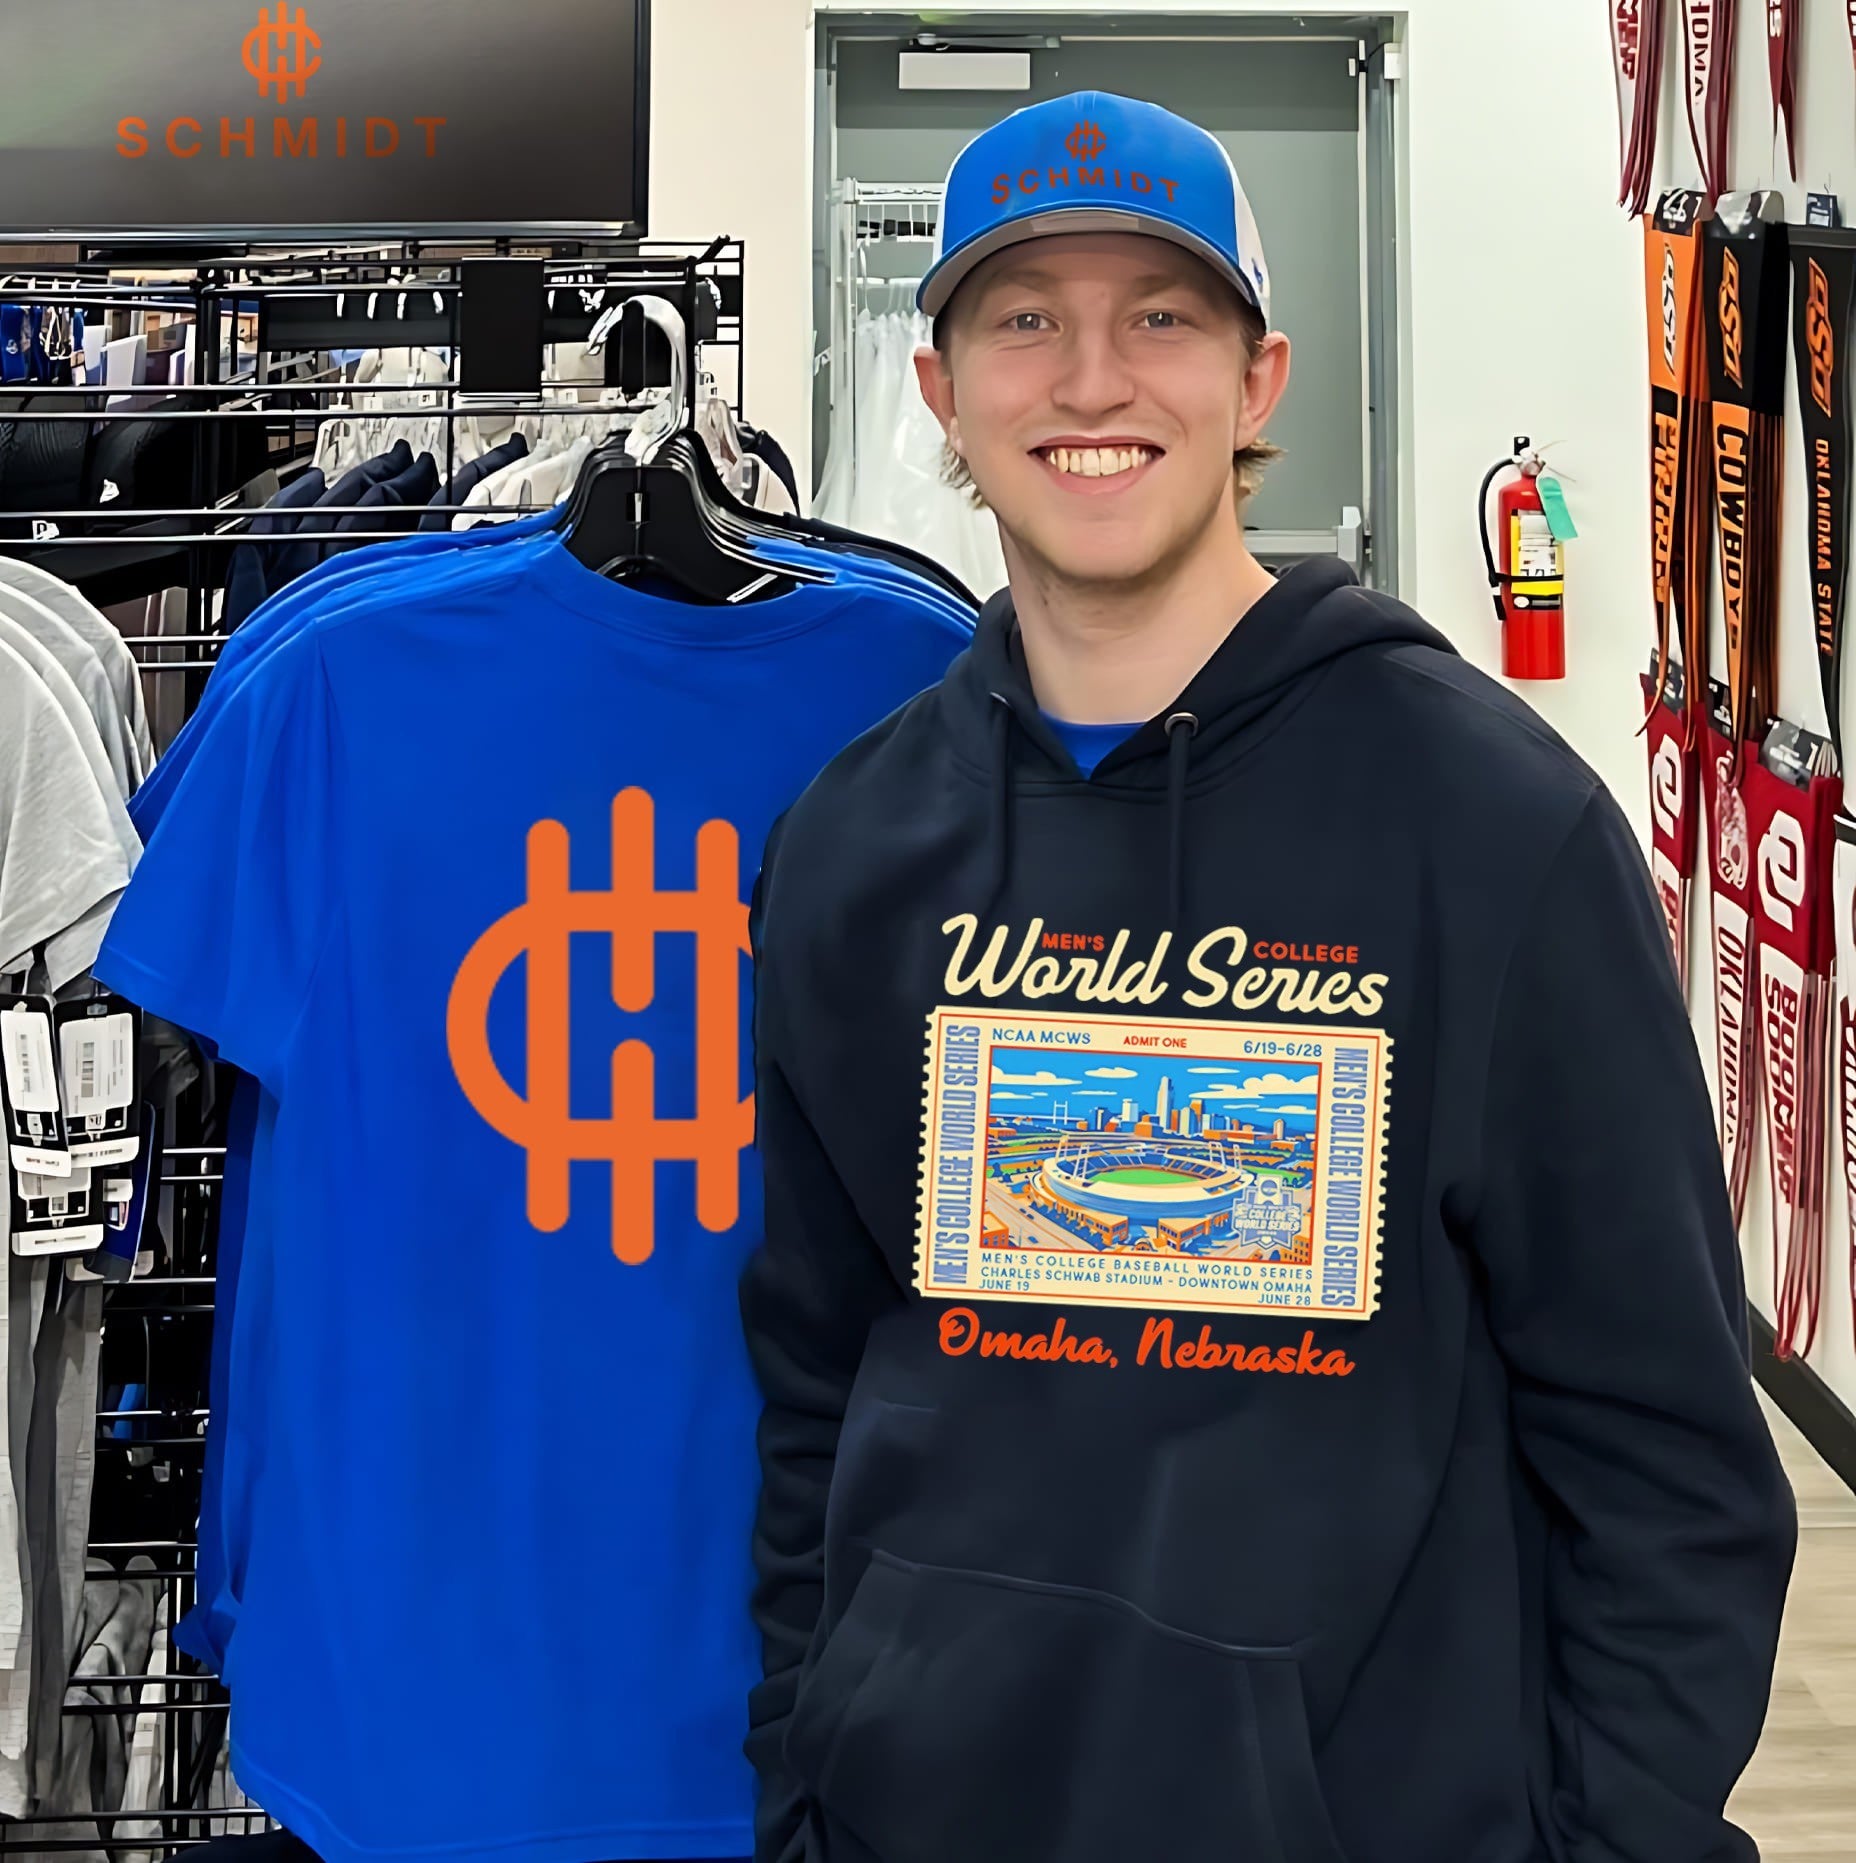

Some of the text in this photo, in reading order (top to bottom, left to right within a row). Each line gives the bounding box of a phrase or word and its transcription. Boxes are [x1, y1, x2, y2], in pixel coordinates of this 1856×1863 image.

[116, 116, 447, 158] SCHMIDT
[992, 167, 1178, 204] SCHMIDT
[1718, 246, 1743, 389] OSU
[1806, 256, 1834, 418] OSU
[1717, 423, 1749, 650] COWBOY
[942, 913, 1389, 1016] World Series
[1042, 933, 1359, 964] MEN'S COLLEGE
[992, 1028, 1091, 1045] NCAA MCWS
[1123, 1035, 1187, 1048] ADMIT ONE
[1243, 1040, 1323, 1057] 6/19-6/28
[933, 1025, 981, 1285] MEN'S COLLEGE WORLD SERIES
[1321, 1047, 1369, 1307] MEN'S COLLEGE WORLD SERIES
[979, 1279, 1030, 1291] JUNE 19
[981, 1267, 1041, 1280] CHARLES
[1045, 1270, 1101, 1283] SCHWAB
[1105, 1273, 1163, 1286] STADIUM
[1178, 1277, 1259, 1291] DOWNTOWN
[1263, 1281, 1312, 1294] OMAHA
[982, 1253, 1313, 1280] MEN'S COLLEGE BASEBALL WORLD SERIES
[1257, 1293, 1312, 1306] JUNE 28
[938, 1307, 1356, 1377] Omaha, Nebraska
